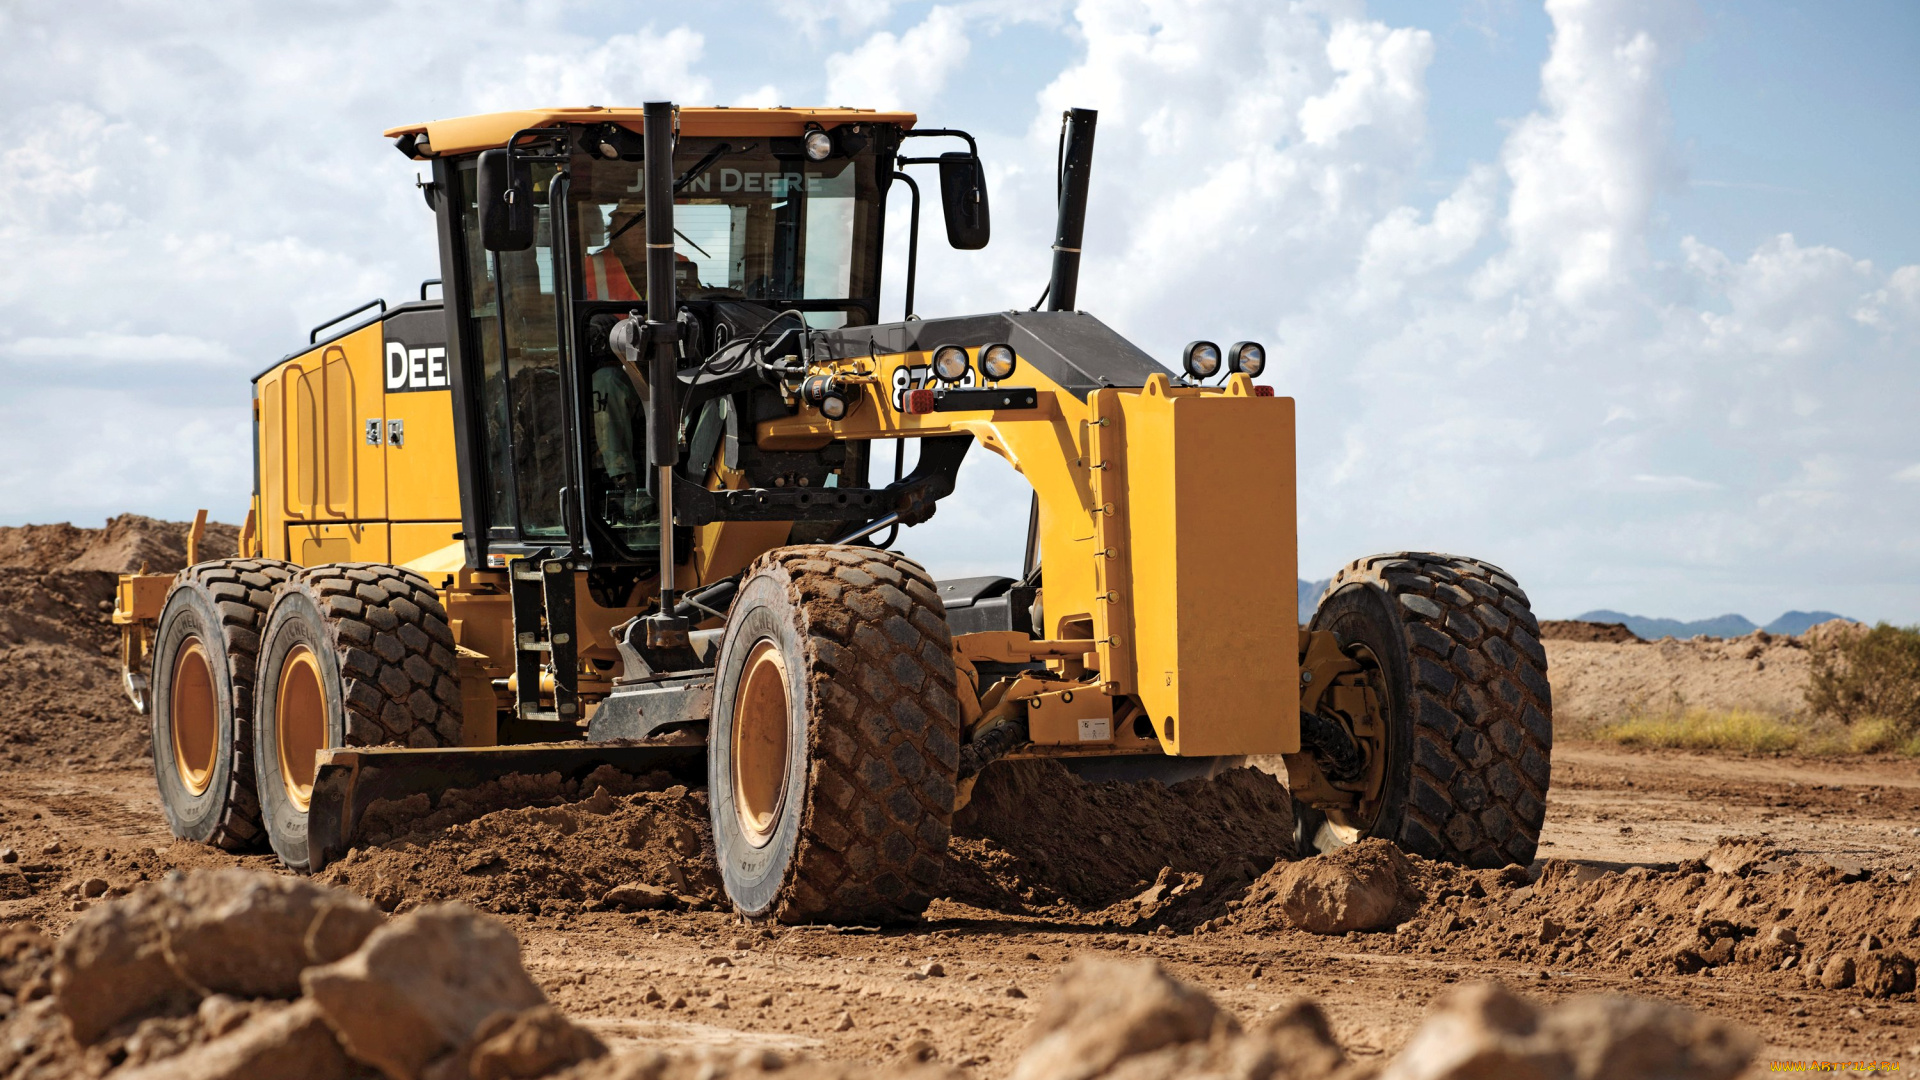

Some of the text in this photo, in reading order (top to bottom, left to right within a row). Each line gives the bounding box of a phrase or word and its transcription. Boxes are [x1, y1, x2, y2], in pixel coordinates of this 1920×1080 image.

[627, 168, 823, 193] JN DEERE
[386, 342, 451, 389] DEE
